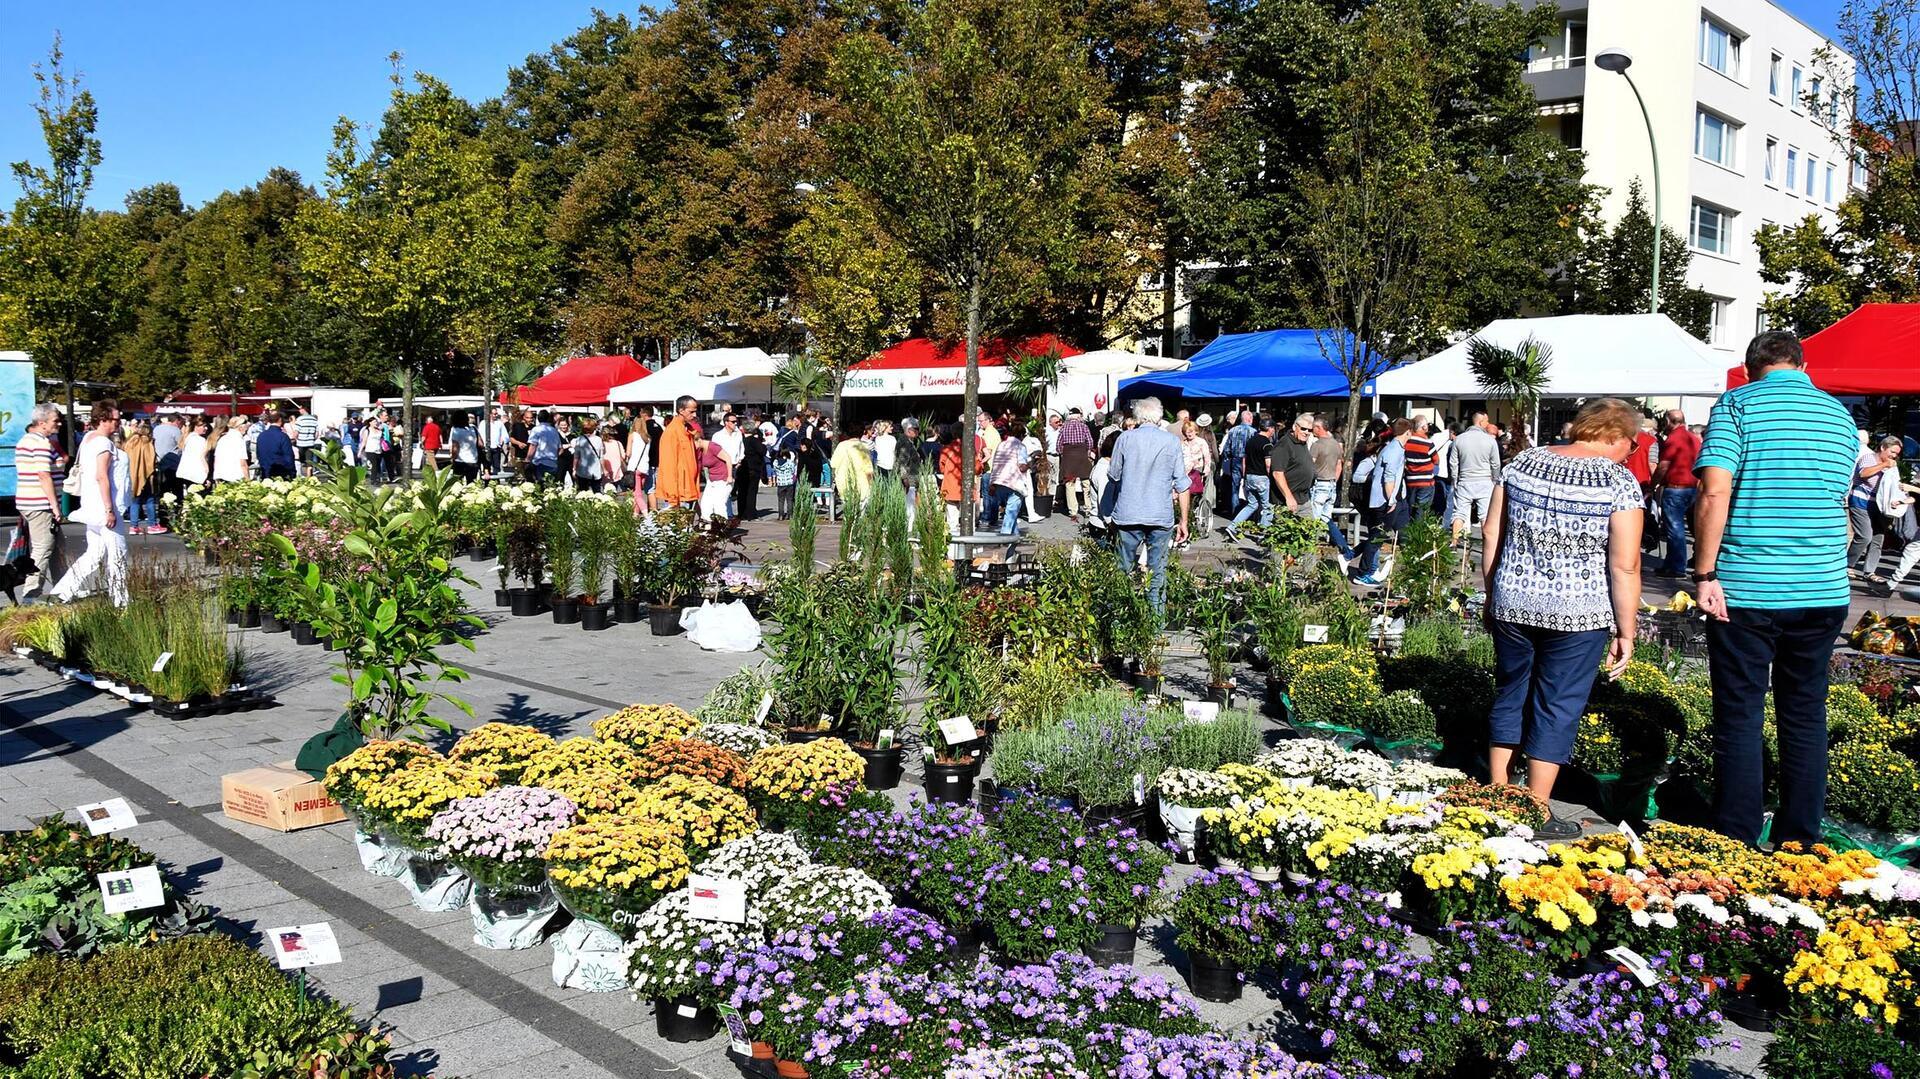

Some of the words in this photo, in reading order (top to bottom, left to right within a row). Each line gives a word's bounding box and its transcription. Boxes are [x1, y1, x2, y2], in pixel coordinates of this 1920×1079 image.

[844, 378, 884, 388] NDISCHER
[919, 370, 967, 387] Blumenki
[294, 798, 342, 812] REMEN
[612, 909, 642, 925] Chr
